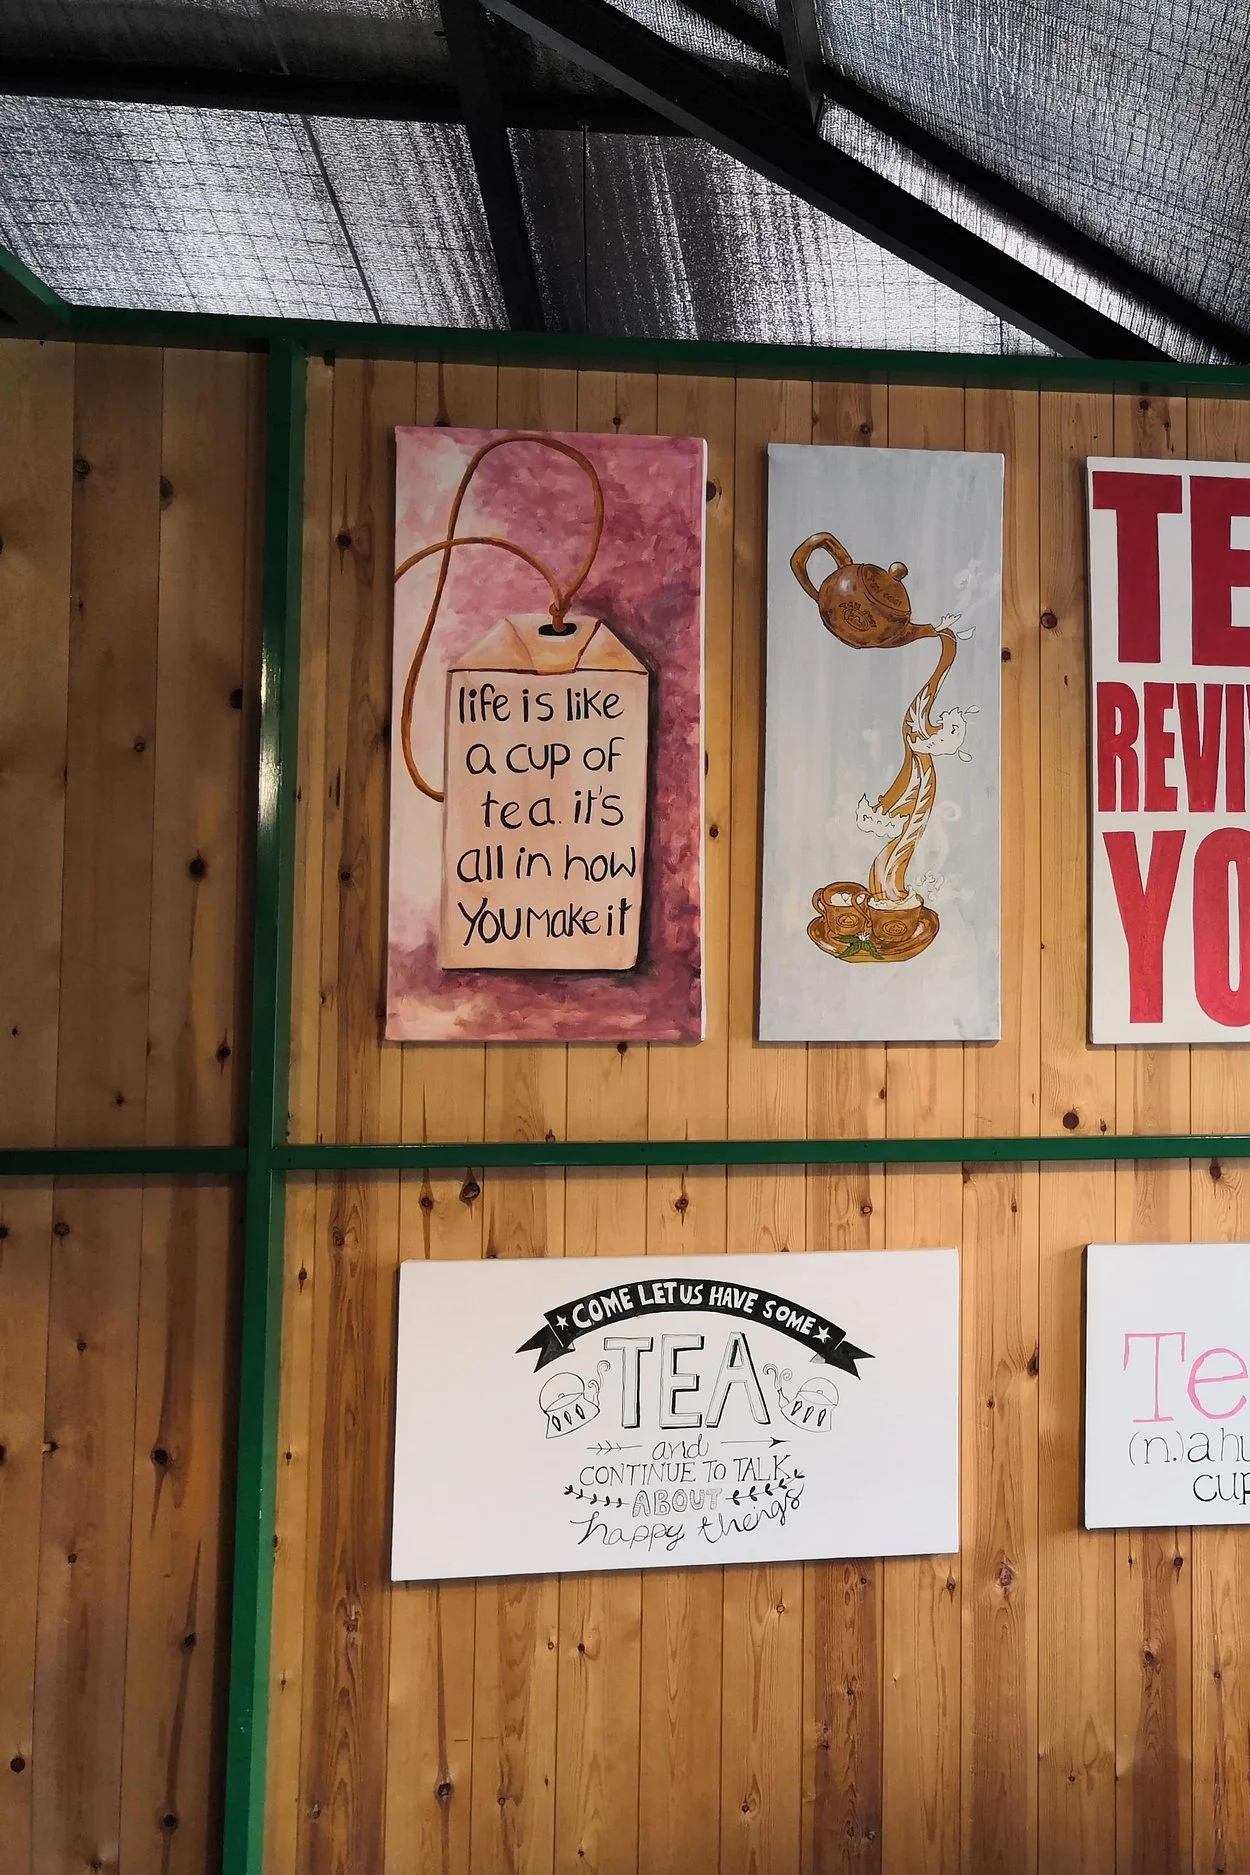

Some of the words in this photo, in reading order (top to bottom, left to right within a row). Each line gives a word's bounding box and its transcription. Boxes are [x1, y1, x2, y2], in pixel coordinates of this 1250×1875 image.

[459, 683, 511, 724] life
[522, 688, 555, 722] is
[465, 743, 497, 774] a
[506, 743, 571, 780] cup
[583, 736, 625, 772] of
[481, 790, 562, 829] tea.
[574, 785, 624, 826] it's
[456, 844, 504, 883] all
[516, 847, 552, 879] in
[564, 844, 636, 882] how
[606, 897, 633, 936] it
[572, 1288, 634, 1329] COME
[709, 1285, 759, 1313] HAVE
[762, 1300, 817, 1335] SOME
[603, 1331, 771, 1430] TEA
[651, 1433, 710, 1460] and
[579, 1461, 696, 1486] CONTINUE
[702, 1459, 727, 1483] TO
[733, 1454, 792, 1482] TALK
[632, 1488, 723, 1518] ABOUT
[570, 1511, 685, 1552] happy
